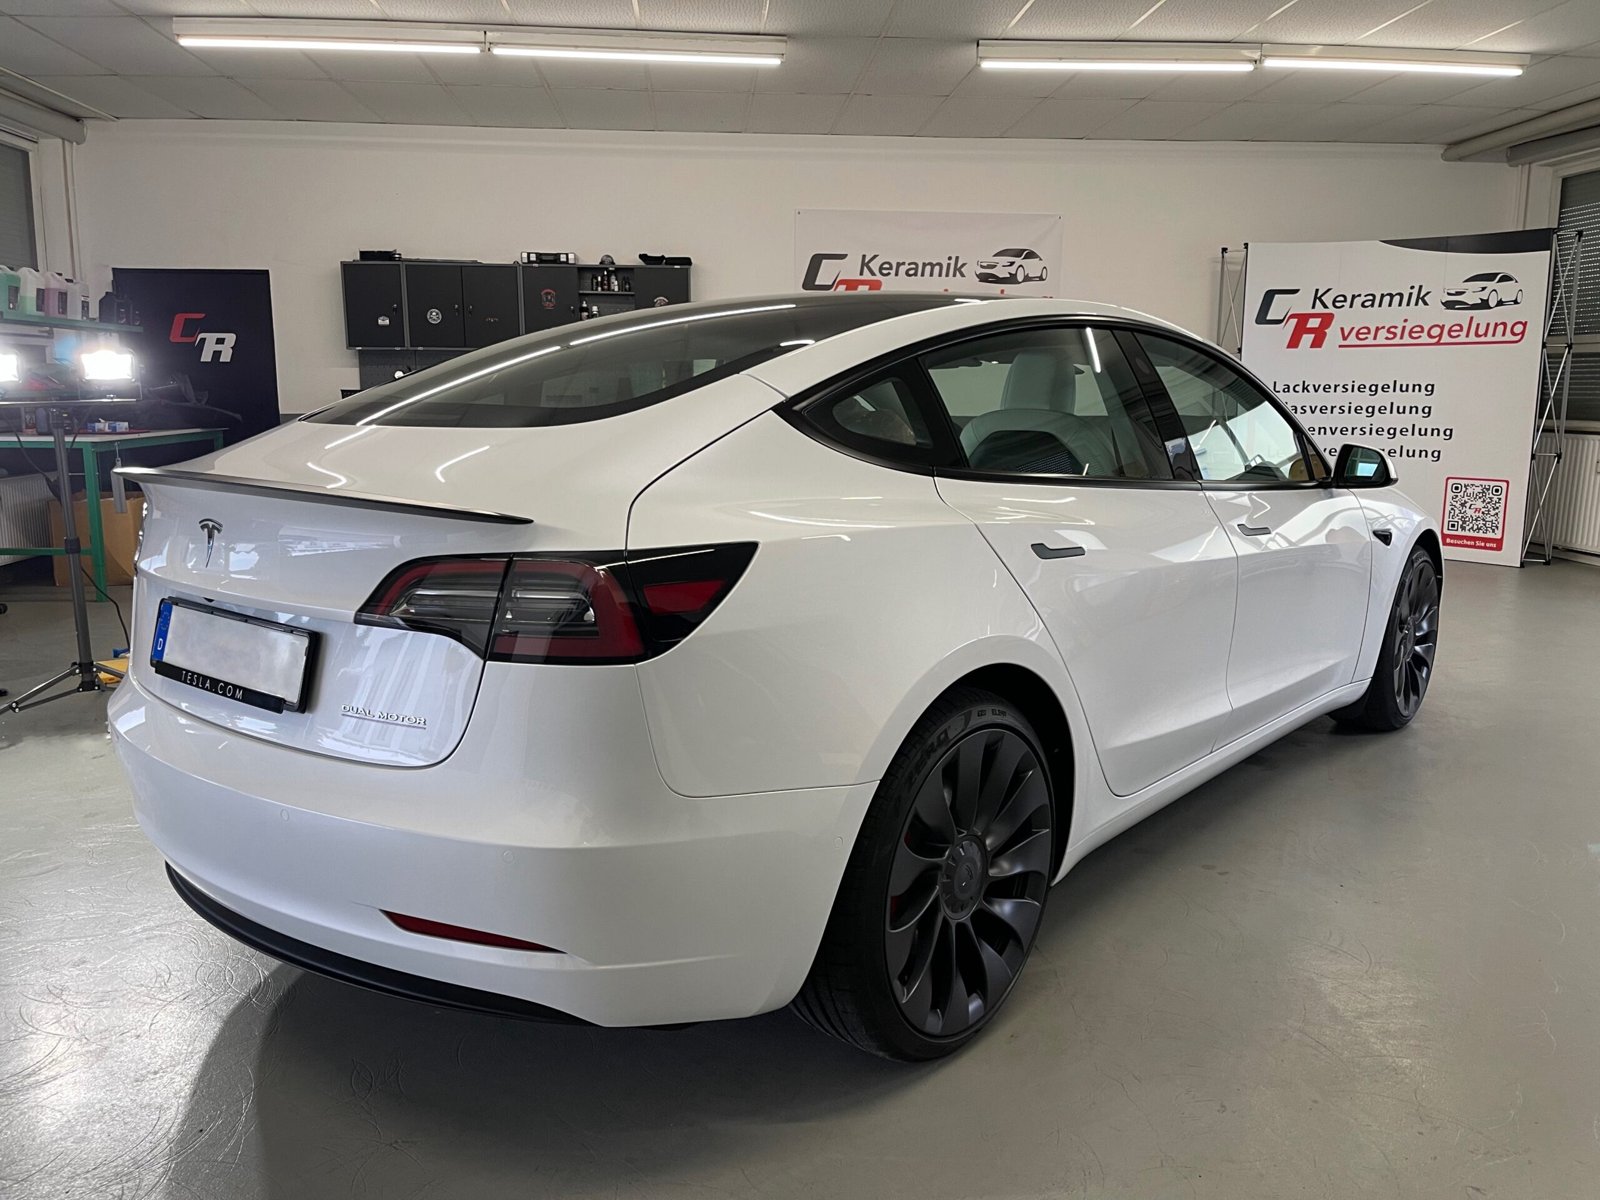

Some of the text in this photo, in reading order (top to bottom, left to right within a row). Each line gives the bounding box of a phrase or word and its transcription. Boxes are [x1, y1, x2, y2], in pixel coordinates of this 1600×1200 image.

[859, 254, 968, 278] Keramik
[1311, 285, 1433, 310] Keramik
[1254, 288, 1335, 349] CR
[1339, 316, 1528, 344] versiegelung
[169, 312, 237, 363] CR
[1273, 379, 1436, 397] Lackversiegelung
[1285, 401, 1433, 418] asversiegelung
[1307, 423, 1455, 441] enversiegelung
[1446, 538, 1474, 546] Besuchen
[181, 670, 244, 700] TESLA.COM
[341, 704, 427, 726] DUAL MOTOR
